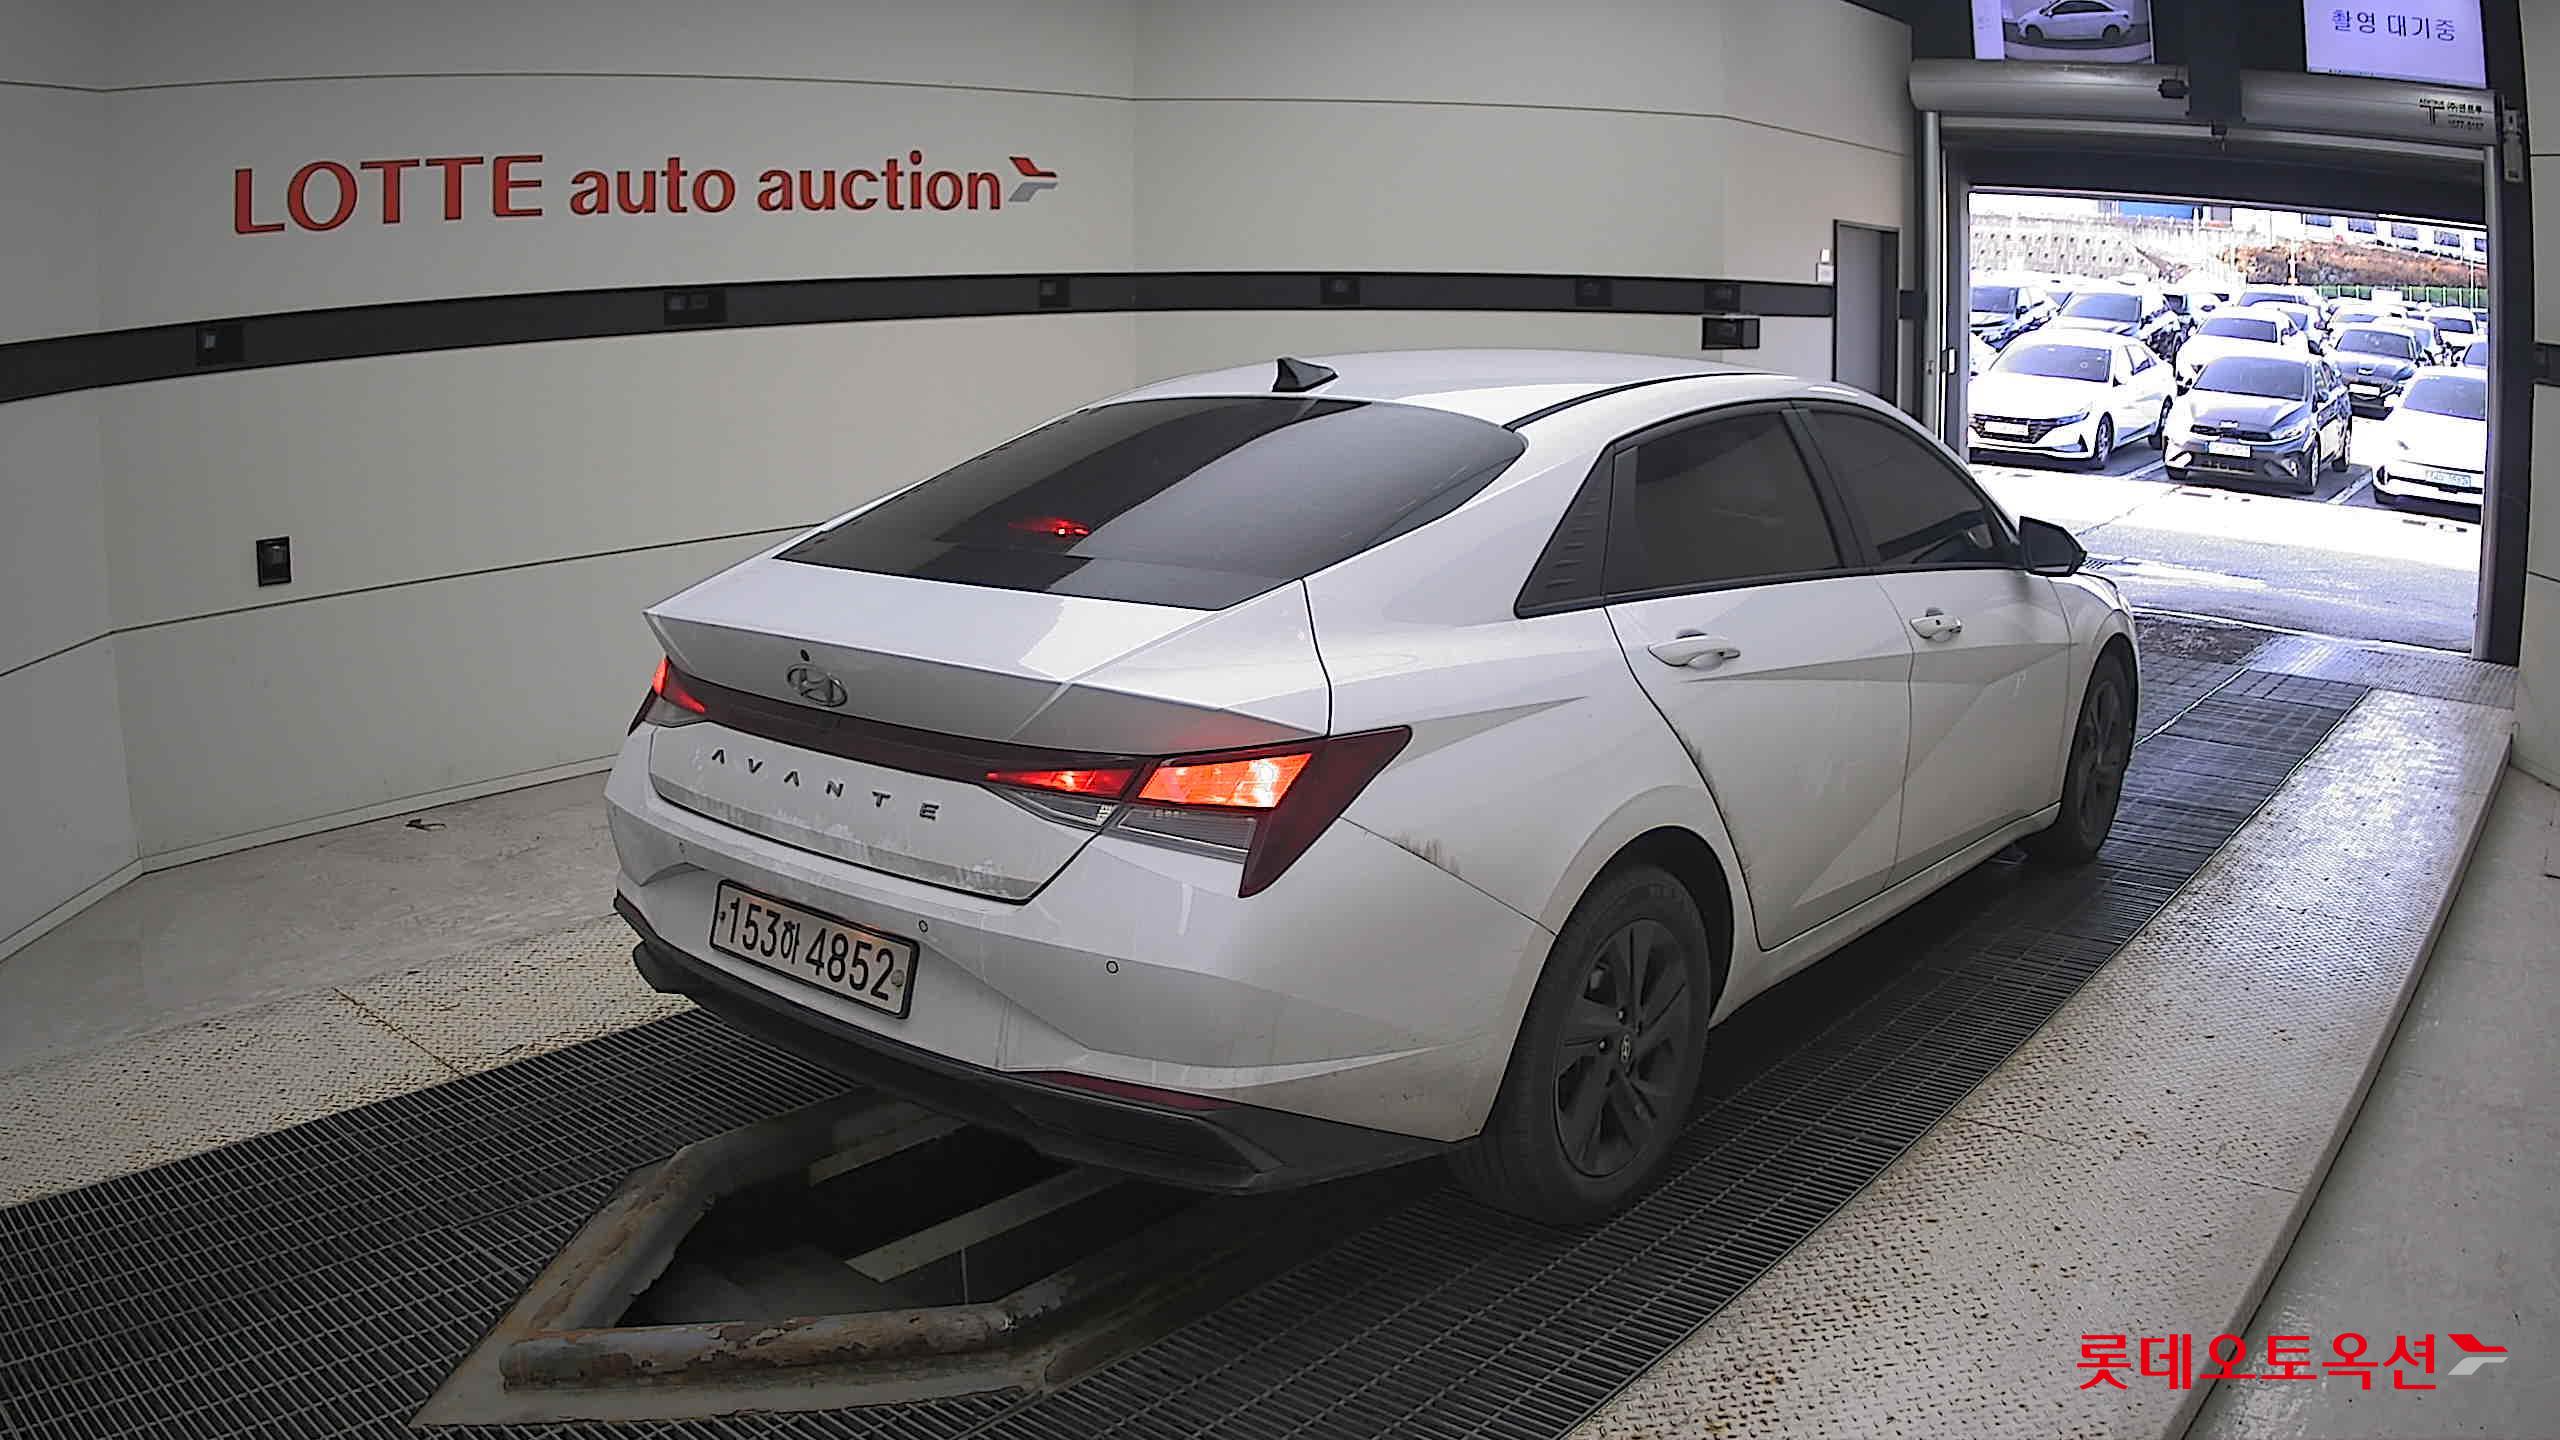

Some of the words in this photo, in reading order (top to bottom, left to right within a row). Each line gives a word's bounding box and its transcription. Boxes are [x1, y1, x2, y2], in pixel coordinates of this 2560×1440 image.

[2331, 9, 2376, 34] 촬영
[2387, 14, 2456, 42] 대기중
[234, 153, 542, 234] LOTTE
[569, 158, 738, 215] auto
[756, 152, 1003, 211] auction
[711, 748, 940, 821] AVANTE
[805, 927, 895, 1002] 4852
